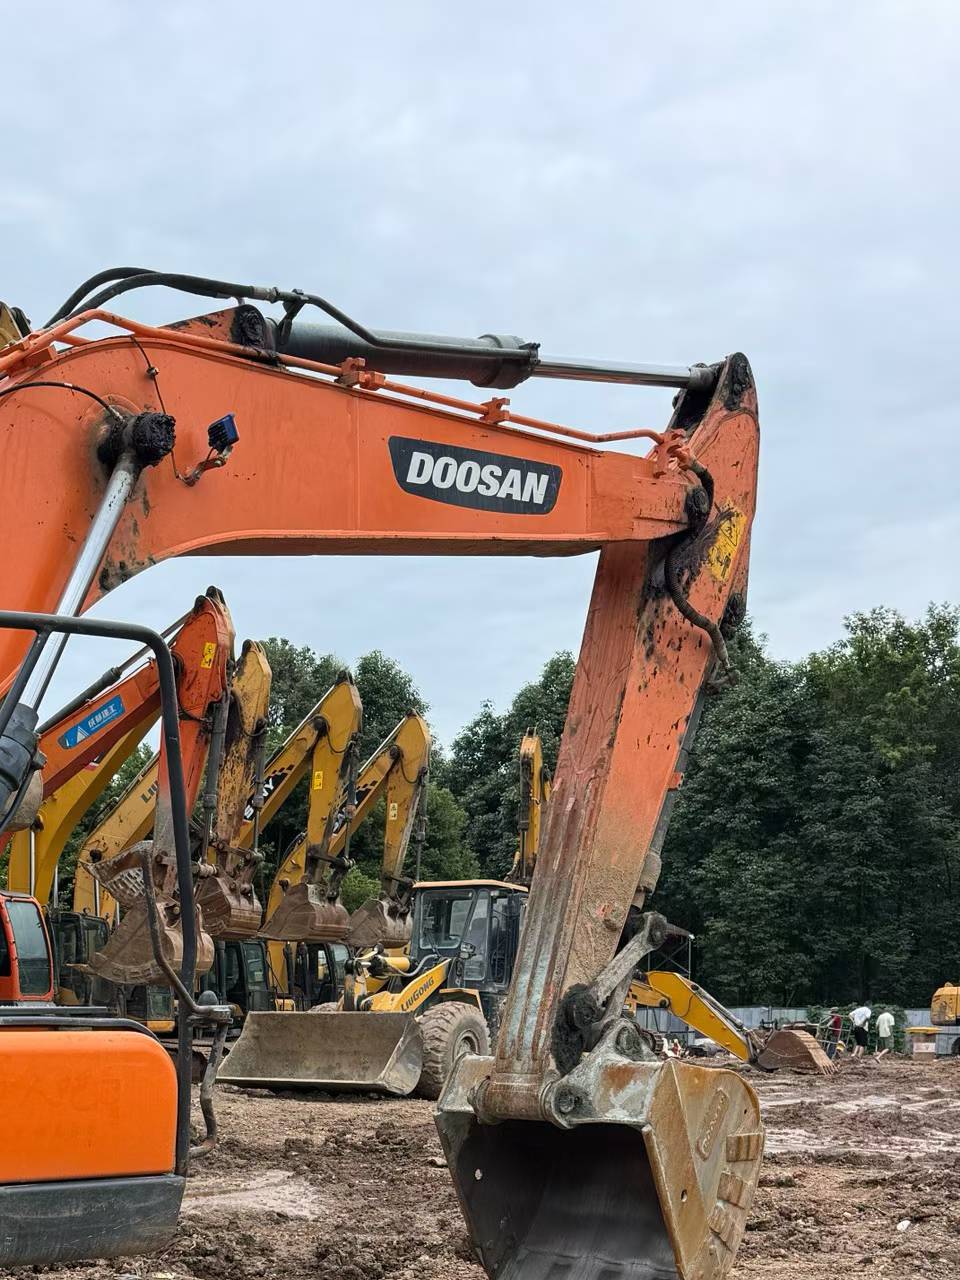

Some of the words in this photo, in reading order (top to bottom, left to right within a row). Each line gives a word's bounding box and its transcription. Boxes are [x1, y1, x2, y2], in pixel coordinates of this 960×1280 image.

[406, 451, 550, 504] DOOSAN
[243, 778, 274, 819] SNY
[400, 976, 435, 1011] LIUGONG
